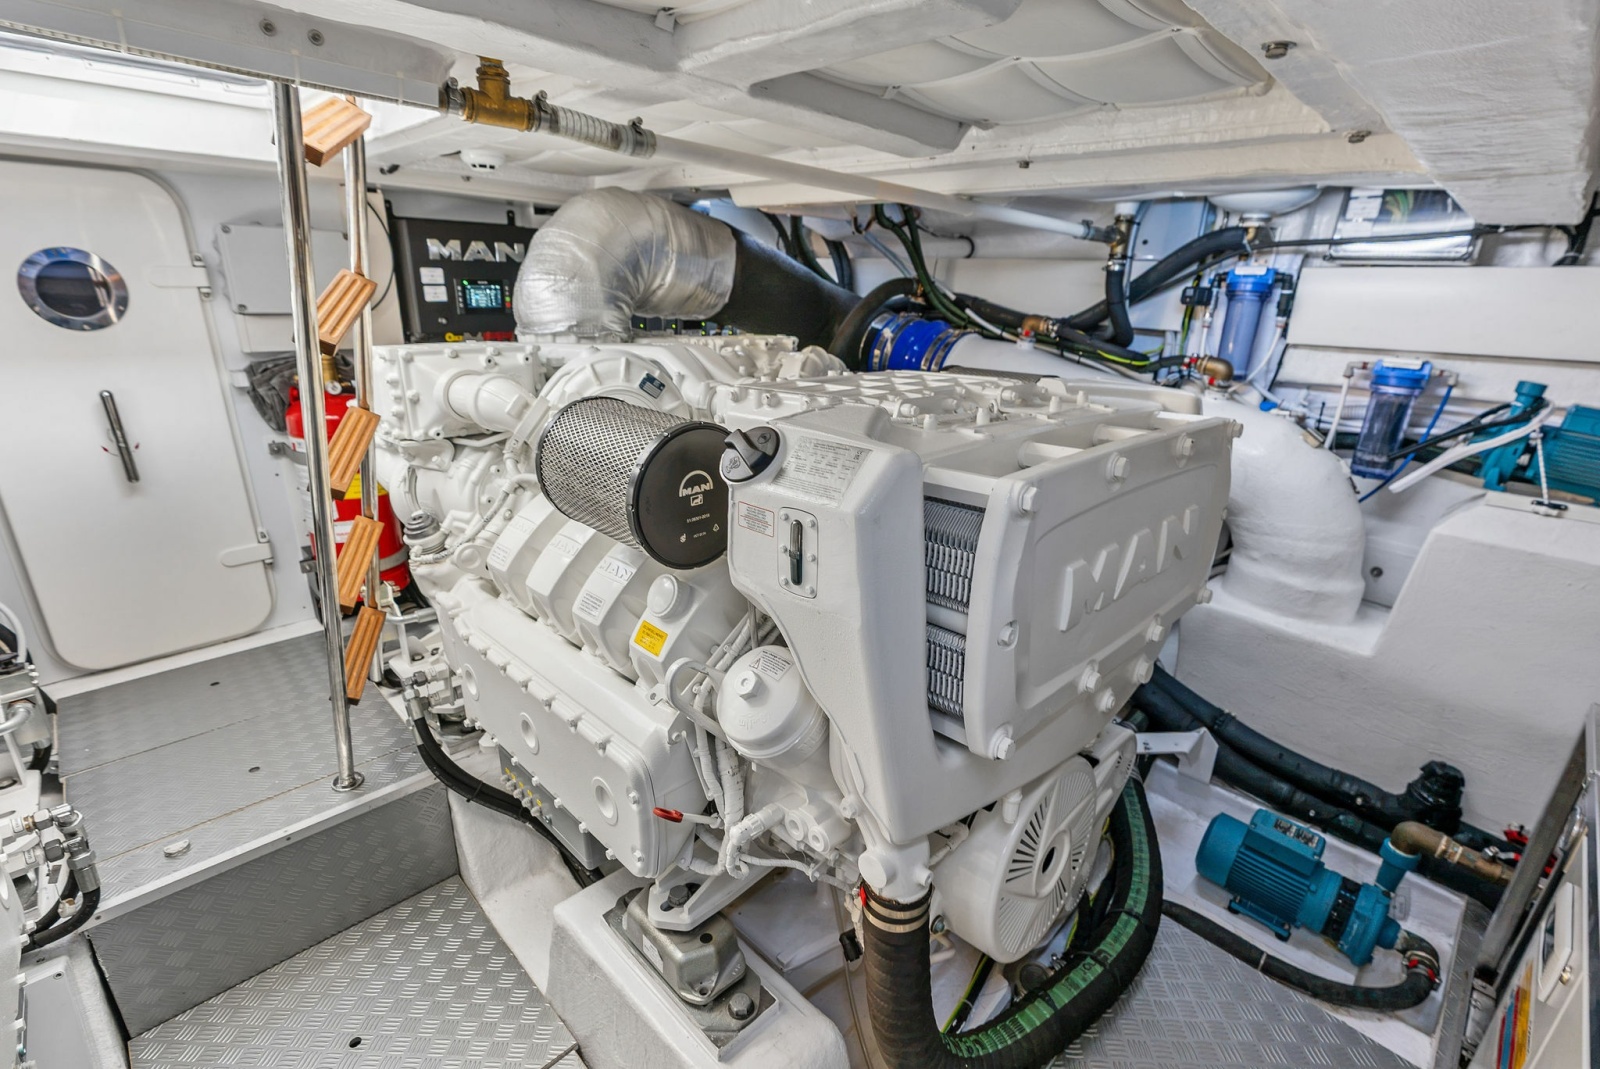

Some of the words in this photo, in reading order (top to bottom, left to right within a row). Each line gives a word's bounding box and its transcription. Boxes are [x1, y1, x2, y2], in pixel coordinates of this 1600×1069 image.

[426, 238, 526, 263] MAN
[682, 482, 710, 497] MAN
[549, 535, 581, 556] MAN
[598, 559, 634, 581] MAN
[1059, 504, 1200, 633] MAN
